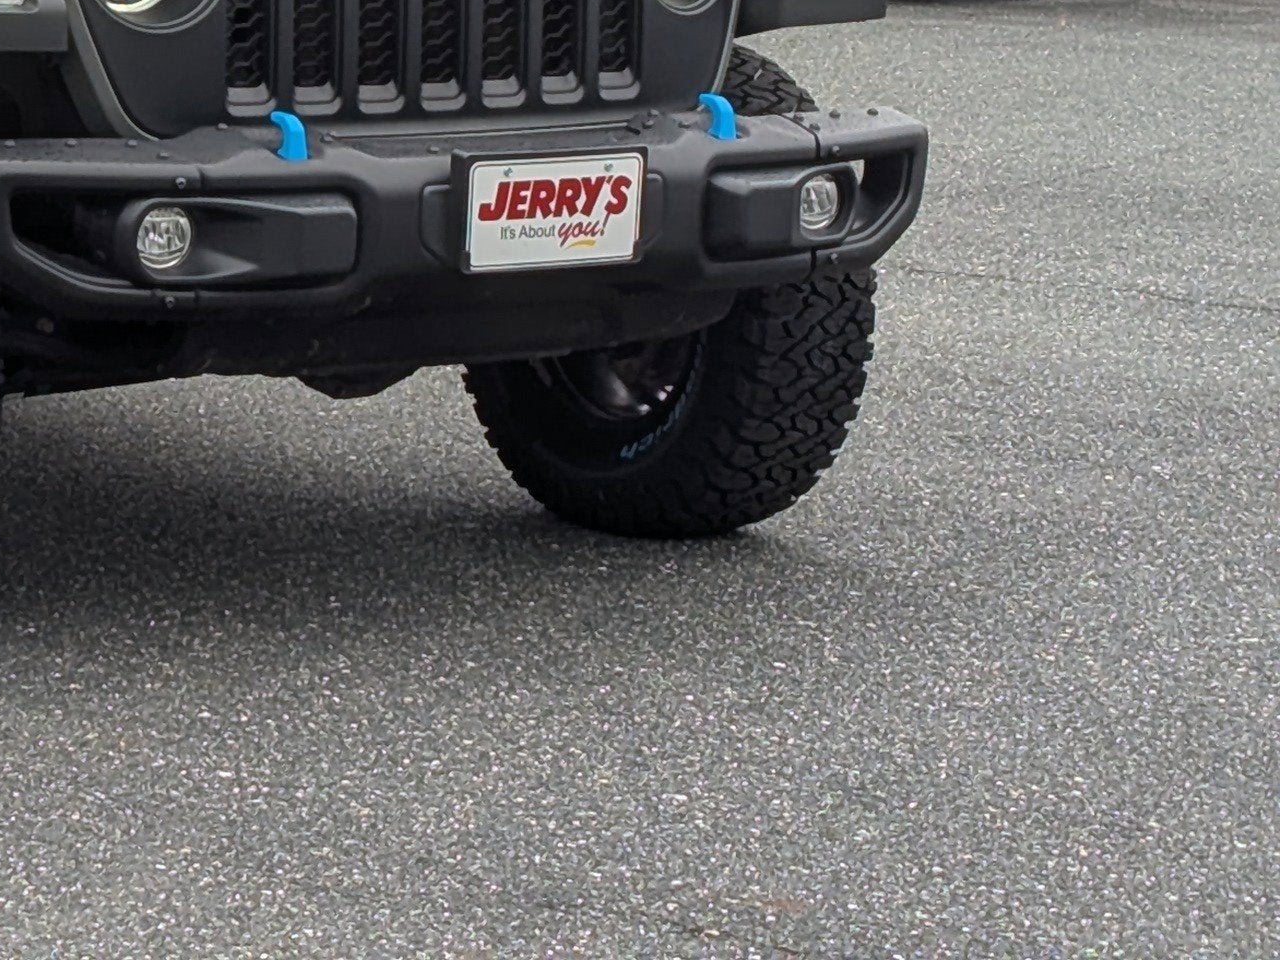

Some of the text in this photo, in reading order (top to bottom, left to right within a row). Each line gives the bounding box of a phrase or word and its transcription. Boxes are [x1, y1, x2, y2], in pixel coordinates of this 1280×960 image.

[478, 175, 632, 222] JERRY'S
[500, 212, 611, 248] It's About you!
